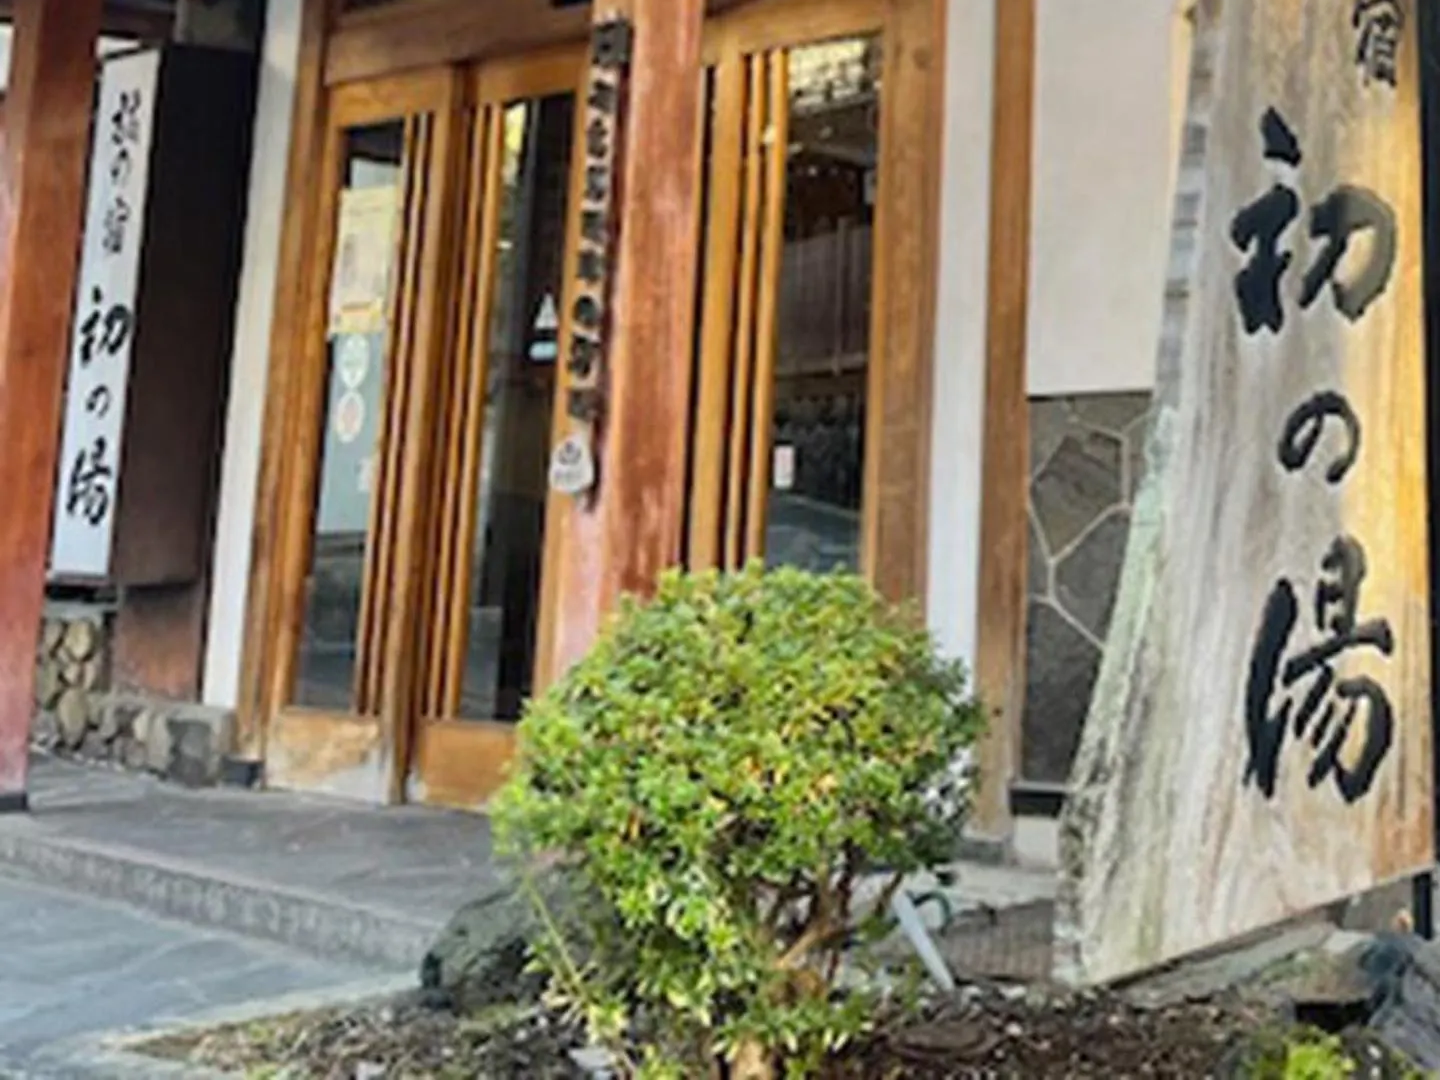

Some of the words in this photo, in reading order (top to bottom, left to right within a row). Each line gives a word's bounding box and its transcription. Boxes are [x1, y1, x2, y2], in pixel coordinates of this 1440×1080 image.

[66, 286, 135, 526] 初の湯
[1229, 106, 1397, 805] 初の湯
